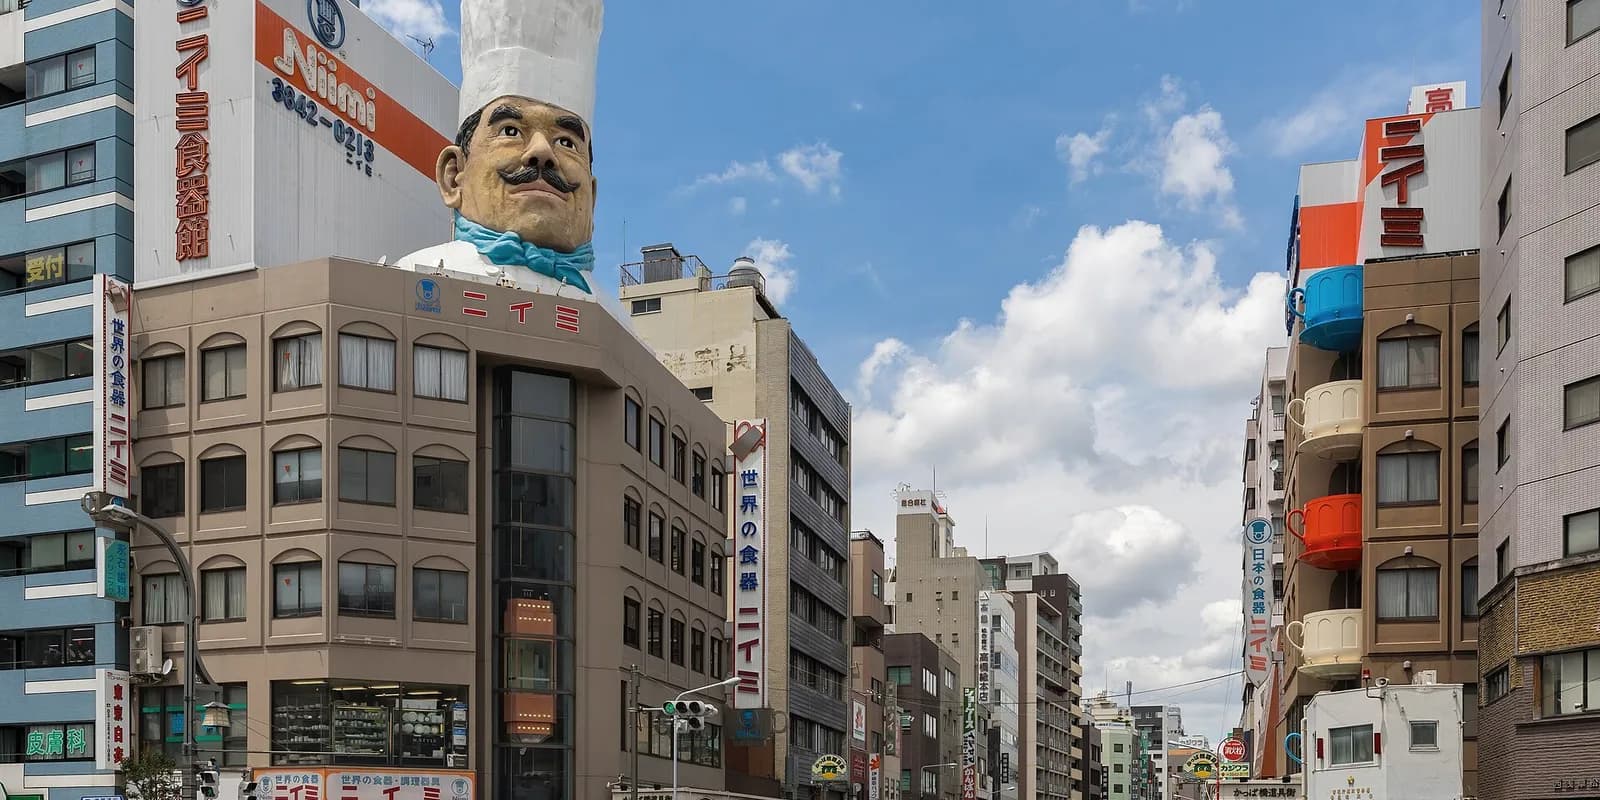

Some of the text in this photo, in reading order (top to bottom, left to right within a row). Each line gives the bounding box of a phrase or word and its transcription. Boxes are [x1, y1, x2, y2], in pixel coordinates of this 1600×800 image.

[272, 77, 375, 163] 3842-0213
[274, 28, 375, 132] Niimi
[176, 6, 209, 262] ニイミ食器館
[1381, 120, 1424, 247] ニイミ
[26, 253, 65, 284] 受付
[463, 291, 580, 333] ニイミ
[110, 318, 127, 485] 世界の食器 ニイミ
[738, 469, 760, 694] 世界の食器 ニイミ
[1250, 548, 1267, 671] 日本の食器 ニイミ
[26, 728, 86, 755] 皮膚科
[275, 774, 319, 785] 世界の食器
[1220, 764, 1249, 773] カジワラ
